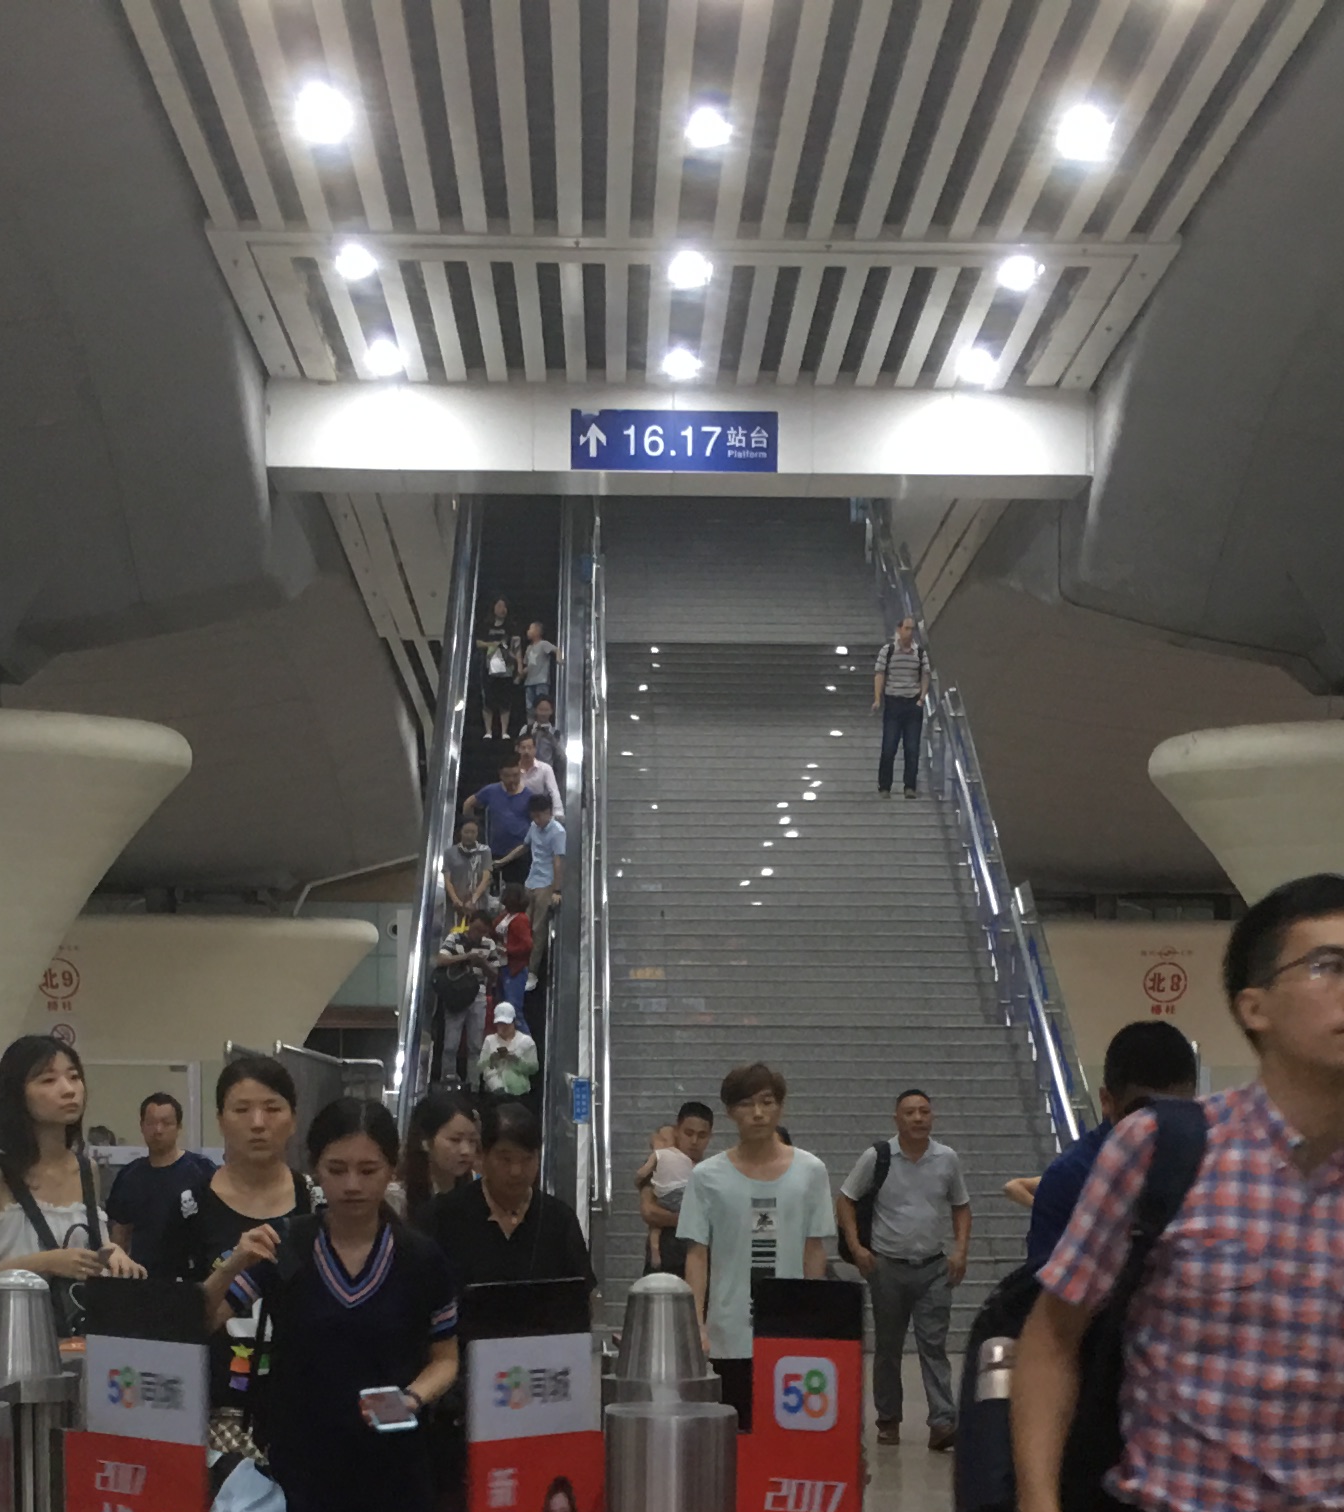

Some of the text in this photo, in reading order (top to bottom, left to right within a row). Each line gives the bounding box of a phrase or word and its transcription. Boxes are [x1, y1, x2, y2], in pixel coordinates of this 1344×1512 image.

[623, 424, 769, 457] 16.17 站台
[727, 449, 768, 459] Platform
